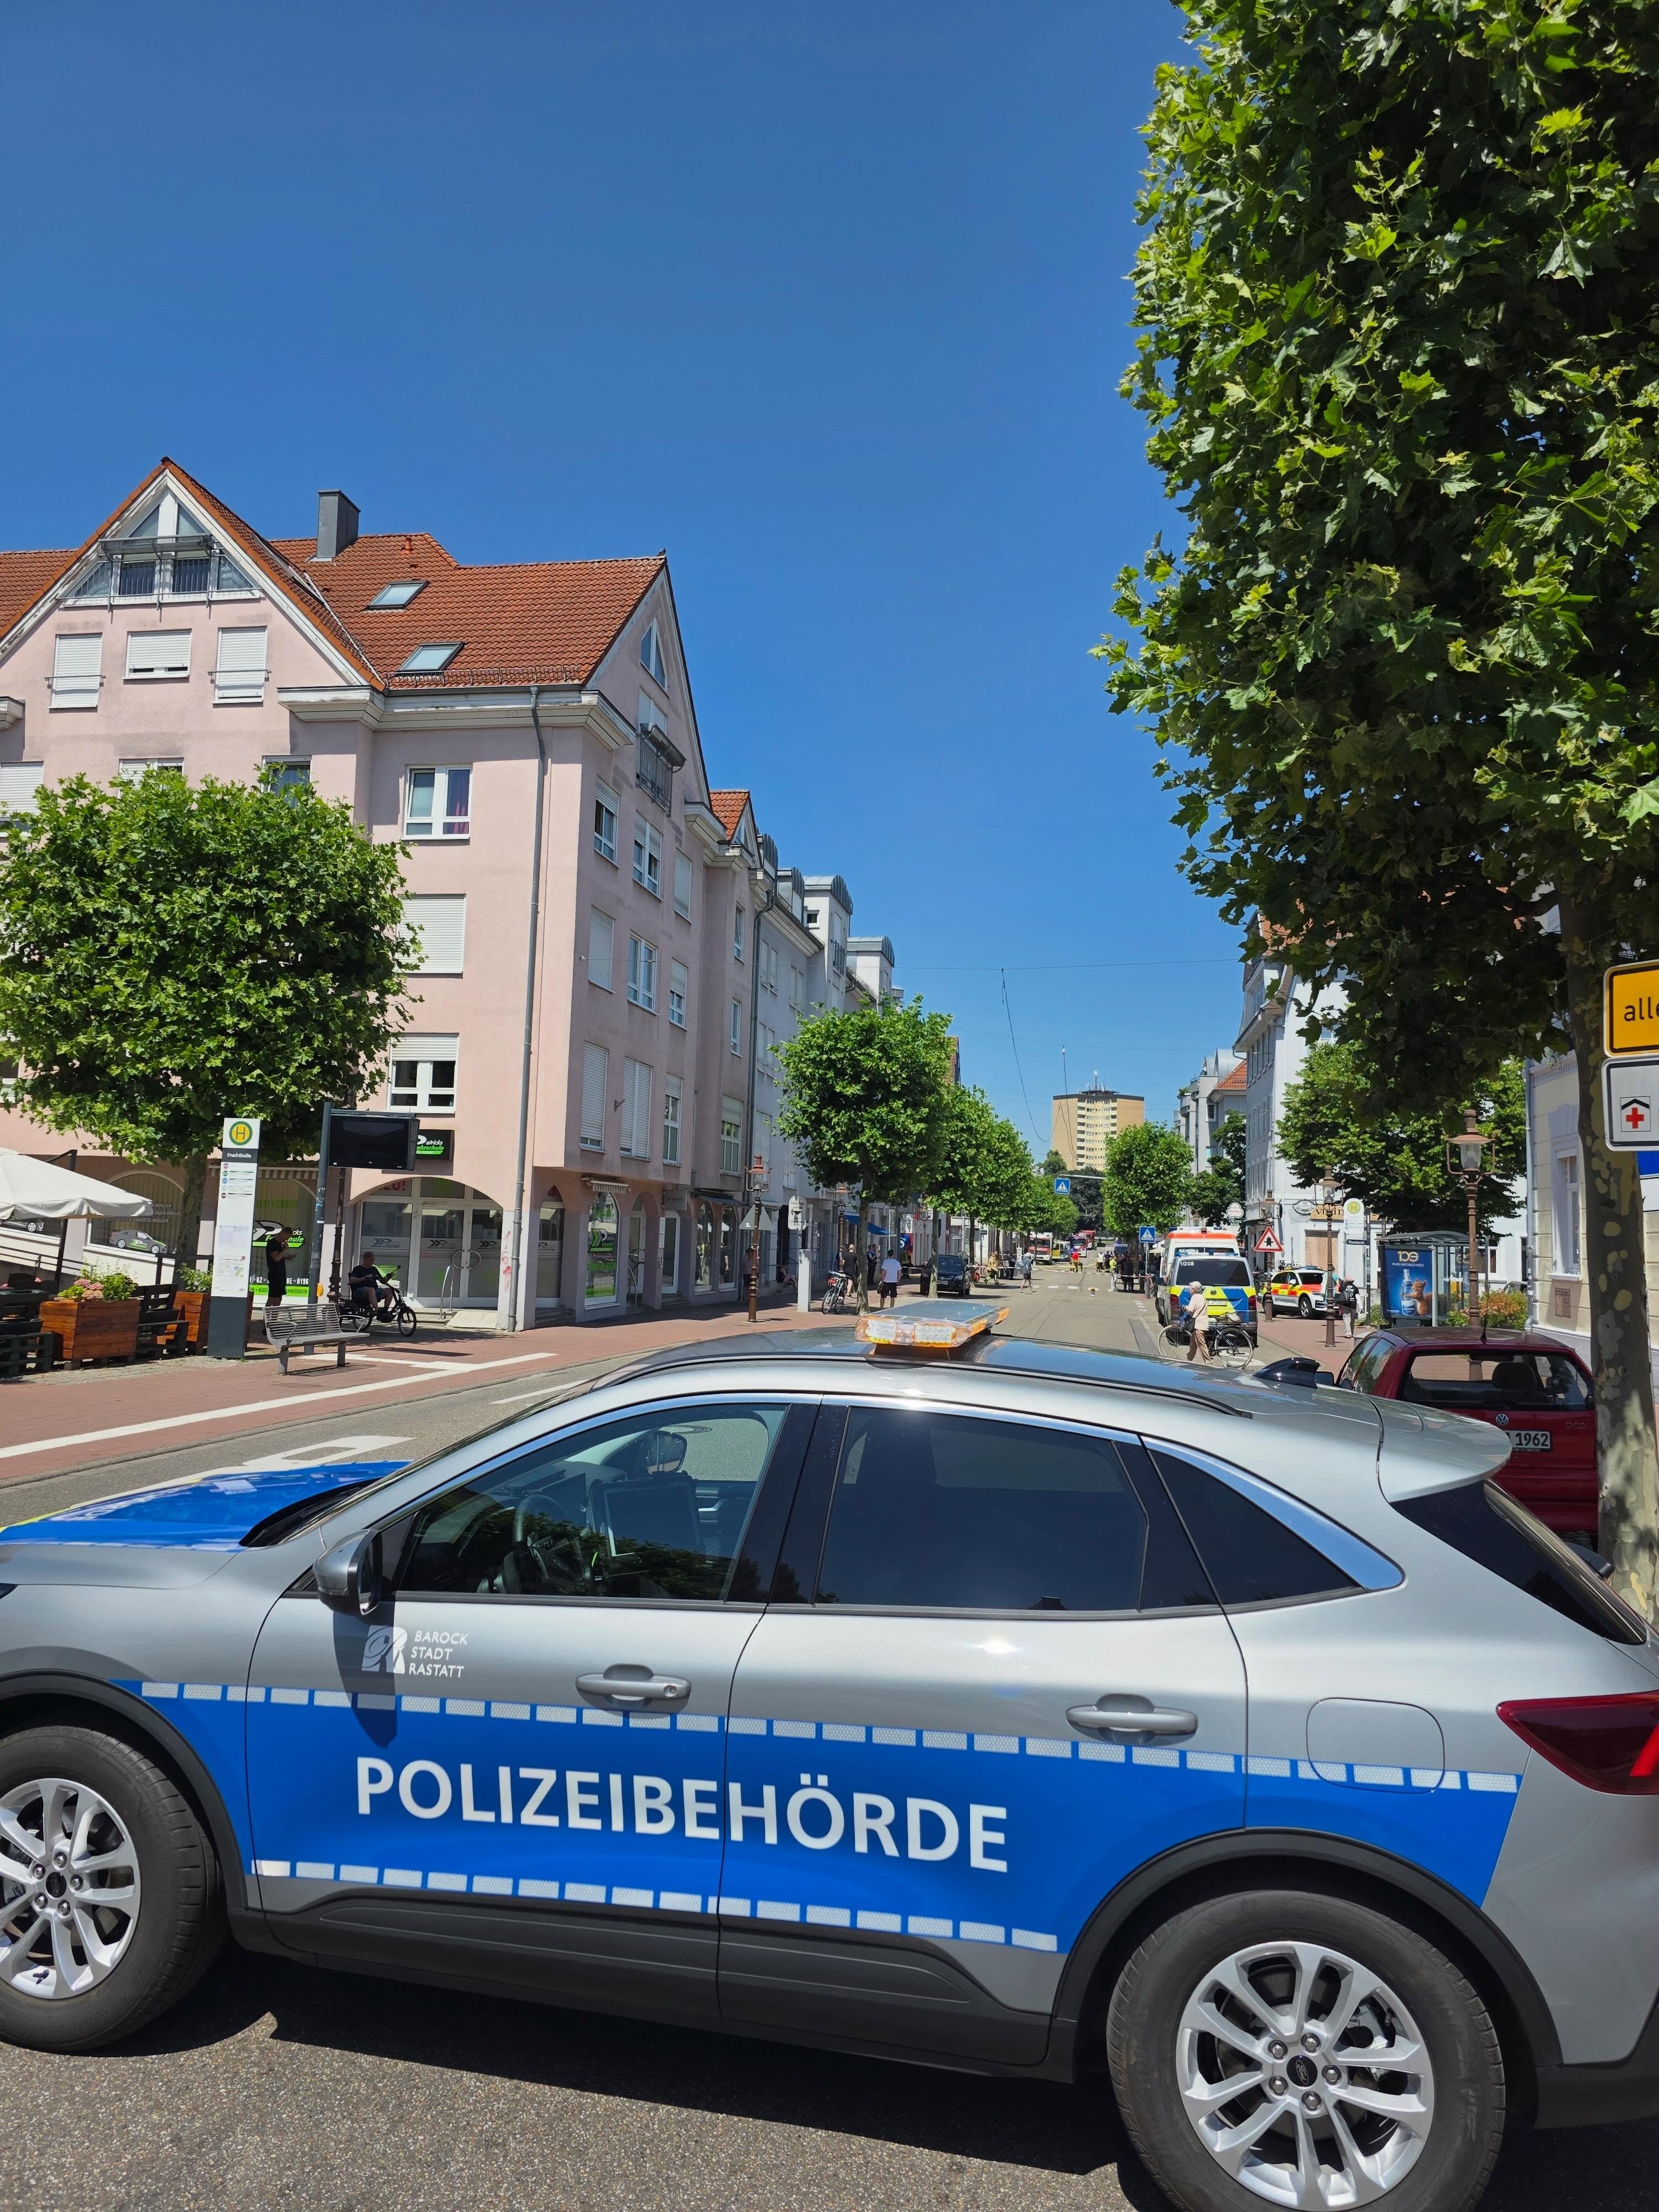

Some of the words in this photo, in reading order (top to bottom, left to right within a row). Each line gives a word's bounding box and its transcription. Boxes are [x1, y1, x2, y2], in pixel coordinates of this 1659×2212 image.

[236, 1126, 246, 1140] H
[1515, 1432, 1549, 1447] 1962
[414, 1630, 469, 1645] BAROCK
[411, 1646, 453, 1661] STADT
[409, 1663, 465, 1678] RASTATT
[356, 1756, 1009, 1874] POLIZEIBEHÖRDE
